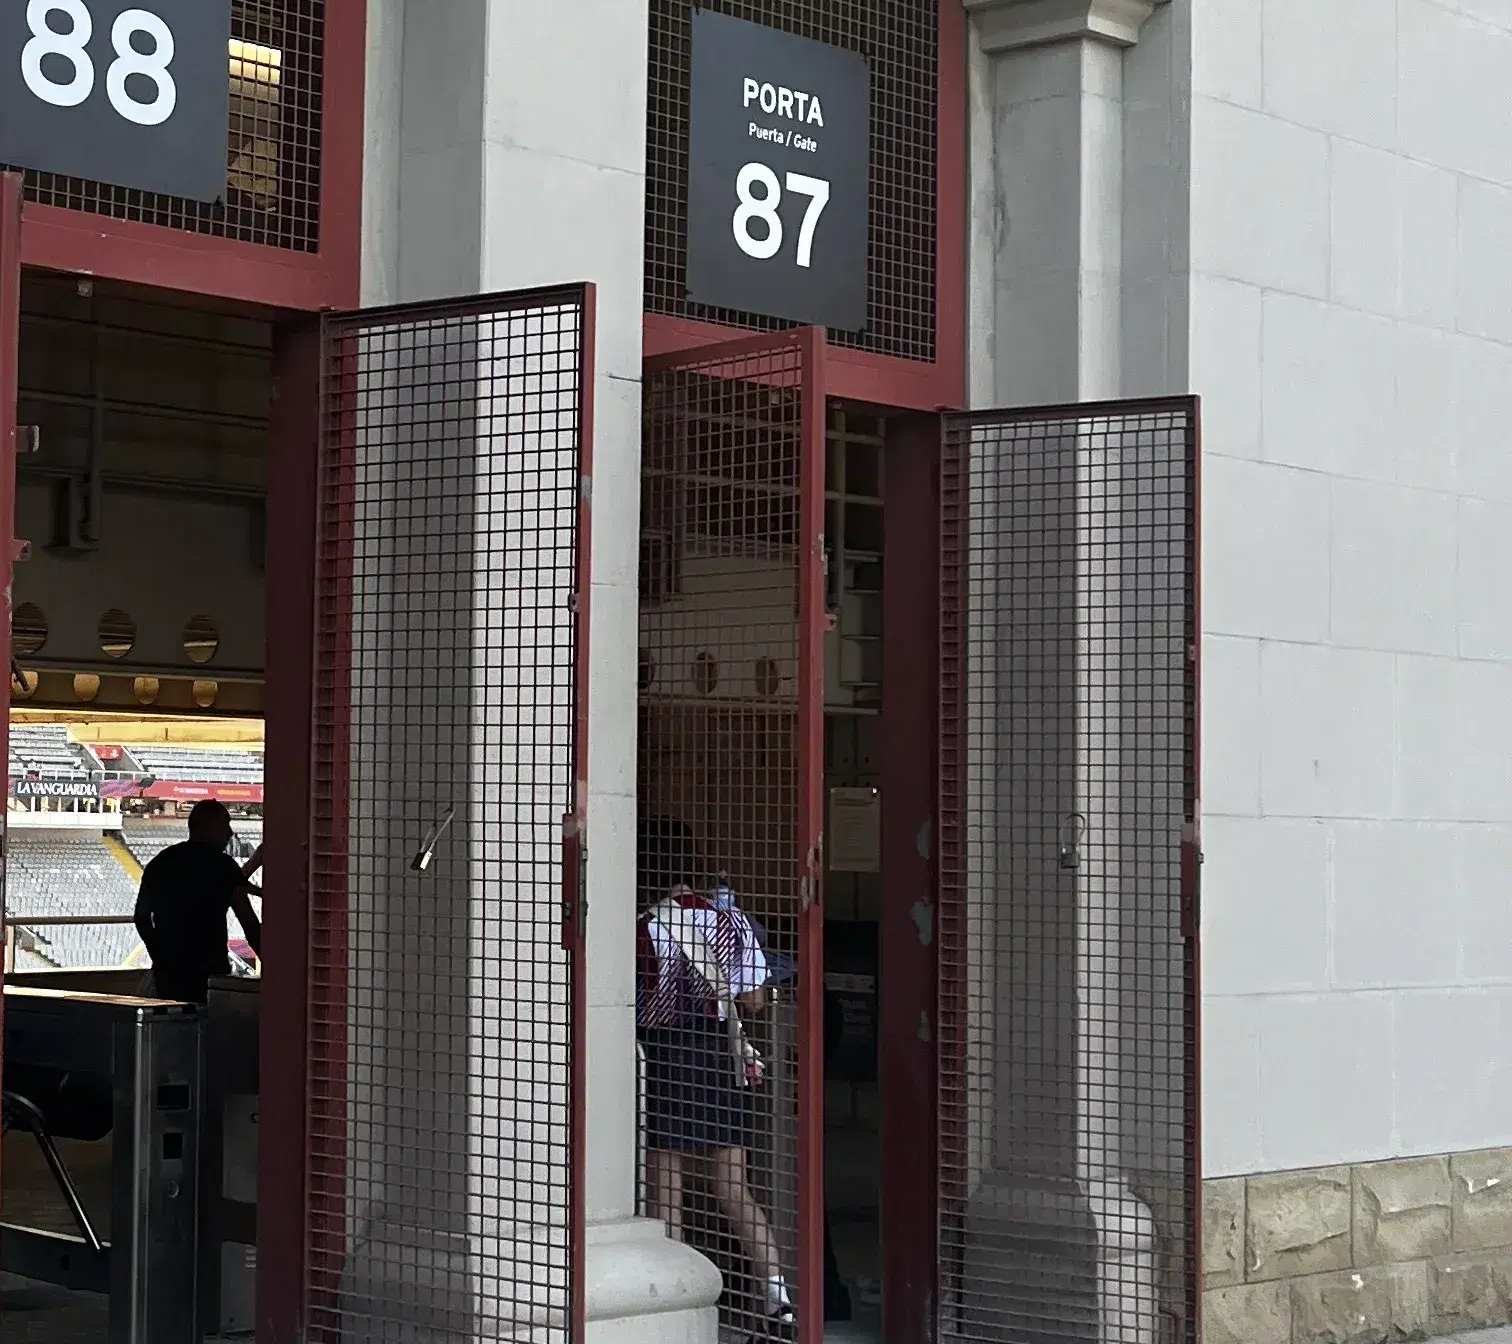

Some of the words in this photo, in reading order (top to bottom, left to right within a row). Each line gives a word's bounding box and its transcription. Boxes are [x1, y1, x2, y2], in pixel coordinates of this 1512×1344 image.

[743, 77, 824, 127] PORTA
[748, 122, 784, 144] Puerta
[785, 131, 793, 146] /
[793, 134, 817, 153] Gate
[732, 162, 830, 268] 87
[17, 782, 31, 794] LA
[31, 782, 98, 796] VANGUARDIA
